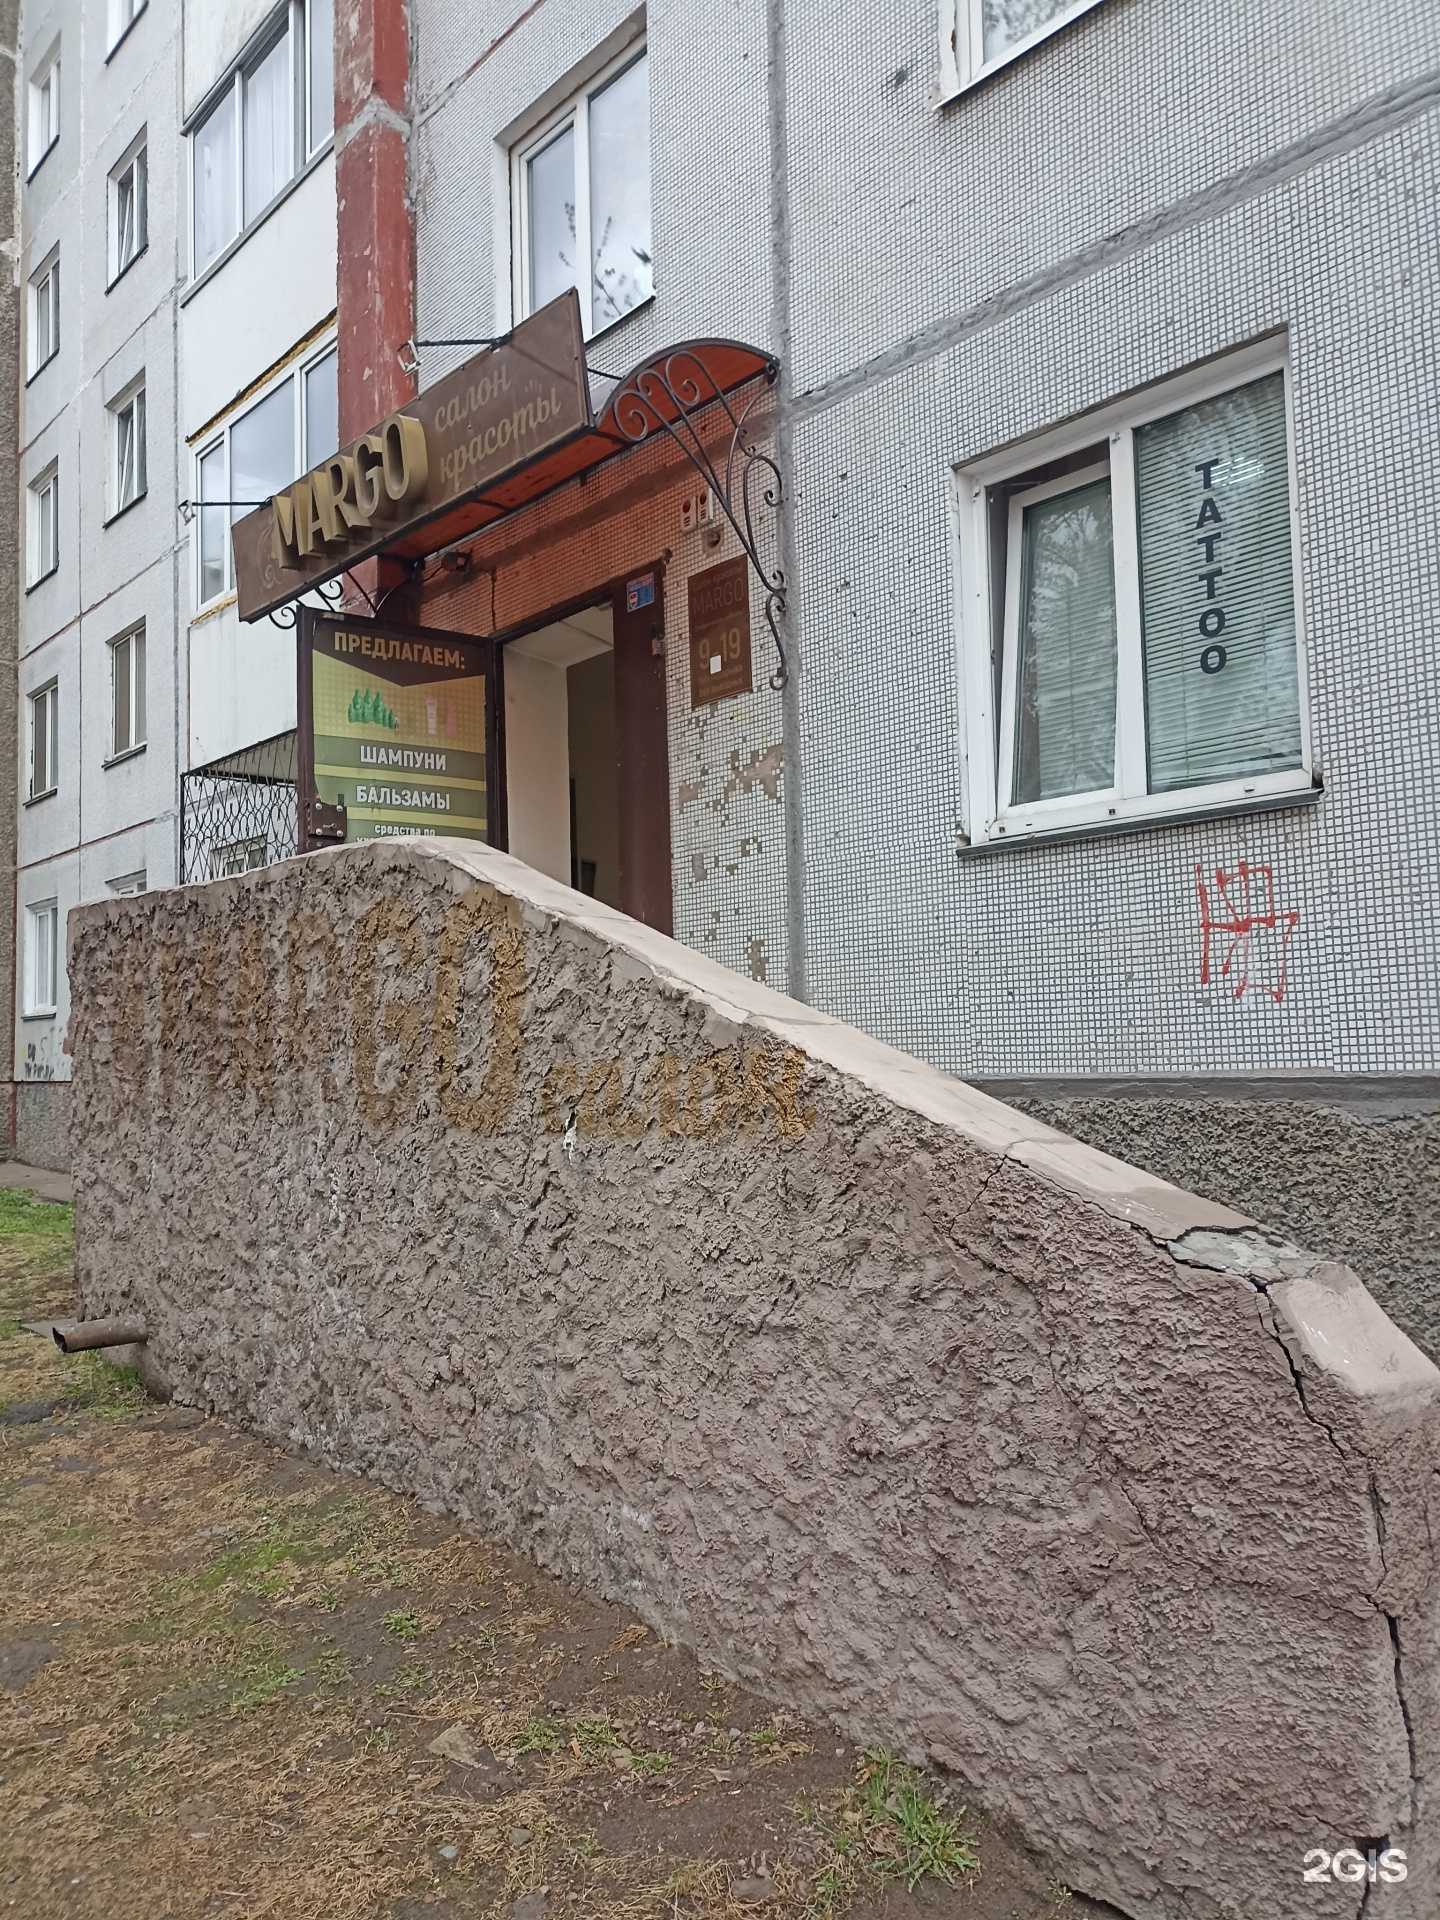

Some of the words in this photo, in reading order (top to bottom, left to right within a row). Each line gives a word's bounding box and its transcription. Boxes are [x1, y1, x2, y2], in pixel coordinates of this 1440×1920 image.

[434, 363, 512, 433] салон
[440, 387, 562, 492] красоты
[271, 413, 428, 569] MARGO
[1194, 458, 1227, 675] TATTOO
[334, 631, 466, 670] ПРЕДЛАГАЕМ:
[360, 745, 447, 771] ШАМПУНИ
[356, 785, 450, 810] БАЛЬЗАМЫ
[374, 824, 421, 838] средства
